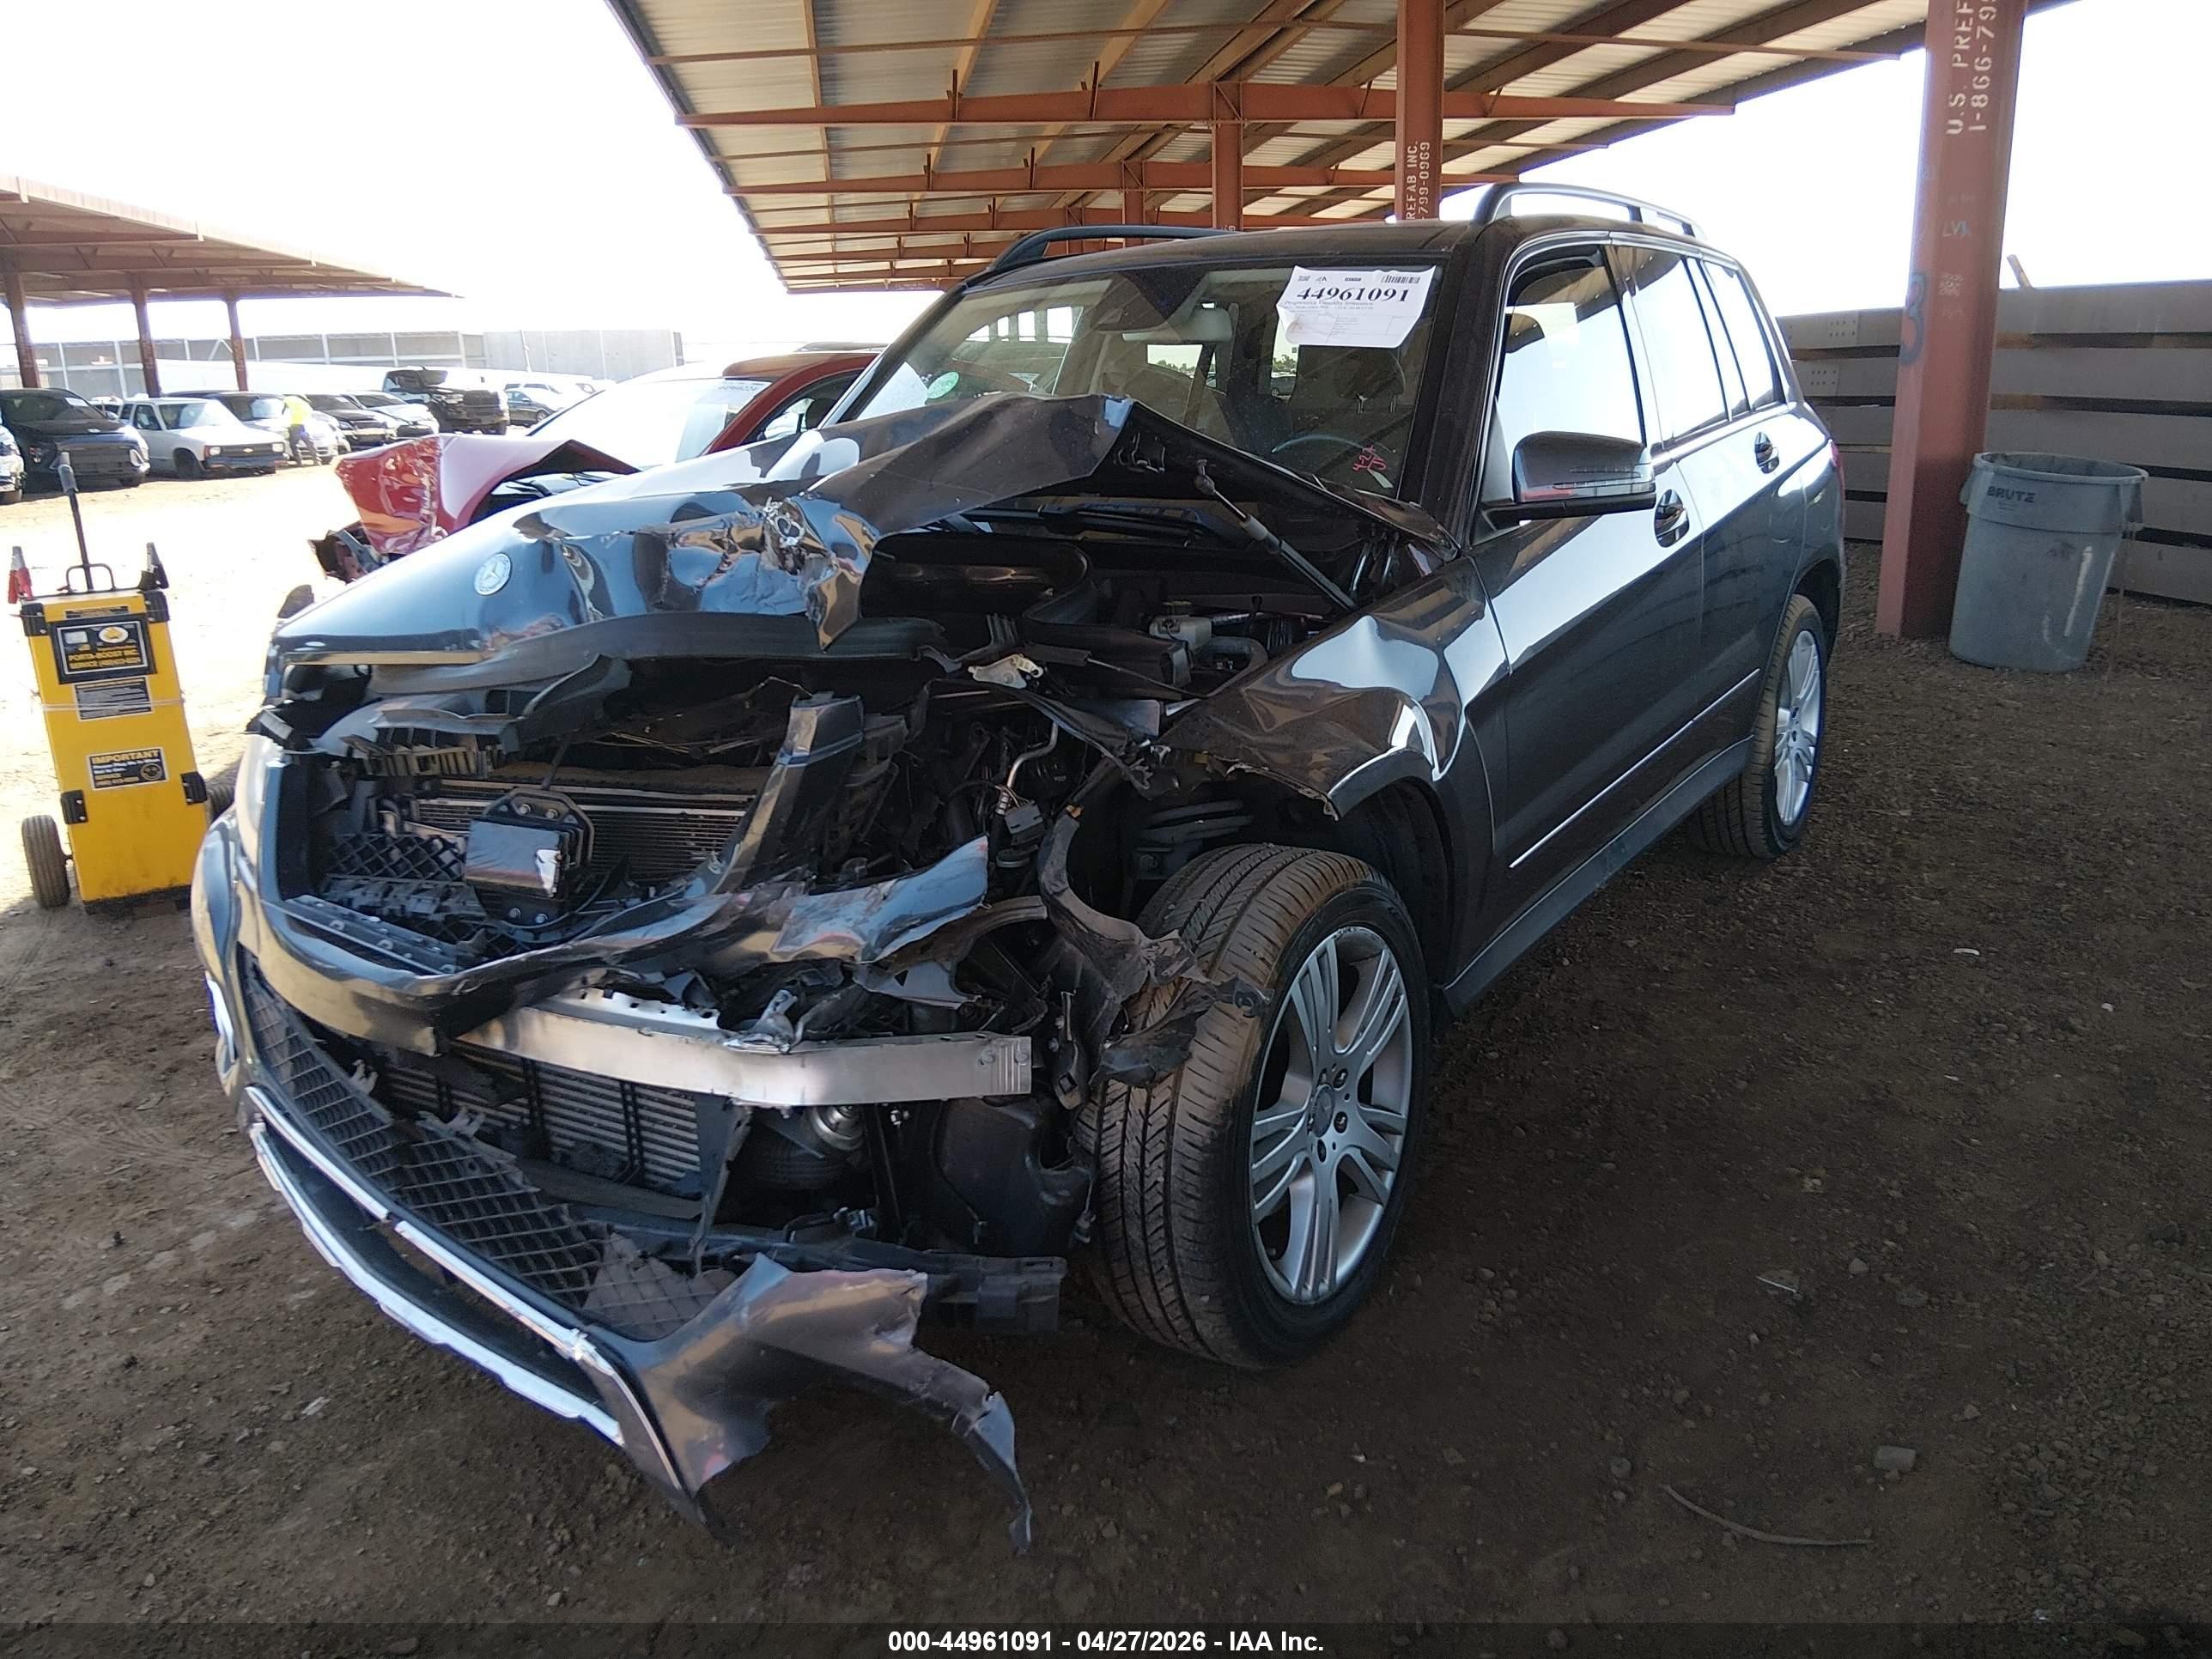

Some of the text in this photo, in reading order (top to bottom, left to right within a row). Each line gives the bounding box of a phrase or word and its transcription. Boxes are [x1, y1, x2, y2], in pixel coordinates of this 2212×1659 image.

[1967, 0, 1998, 131] 1-866-79
[1407, 140, 1419, 168] INC.
[1297, 286, 1410, 303] 44961091
[91, 750, 159, 764] IMPORTANT
